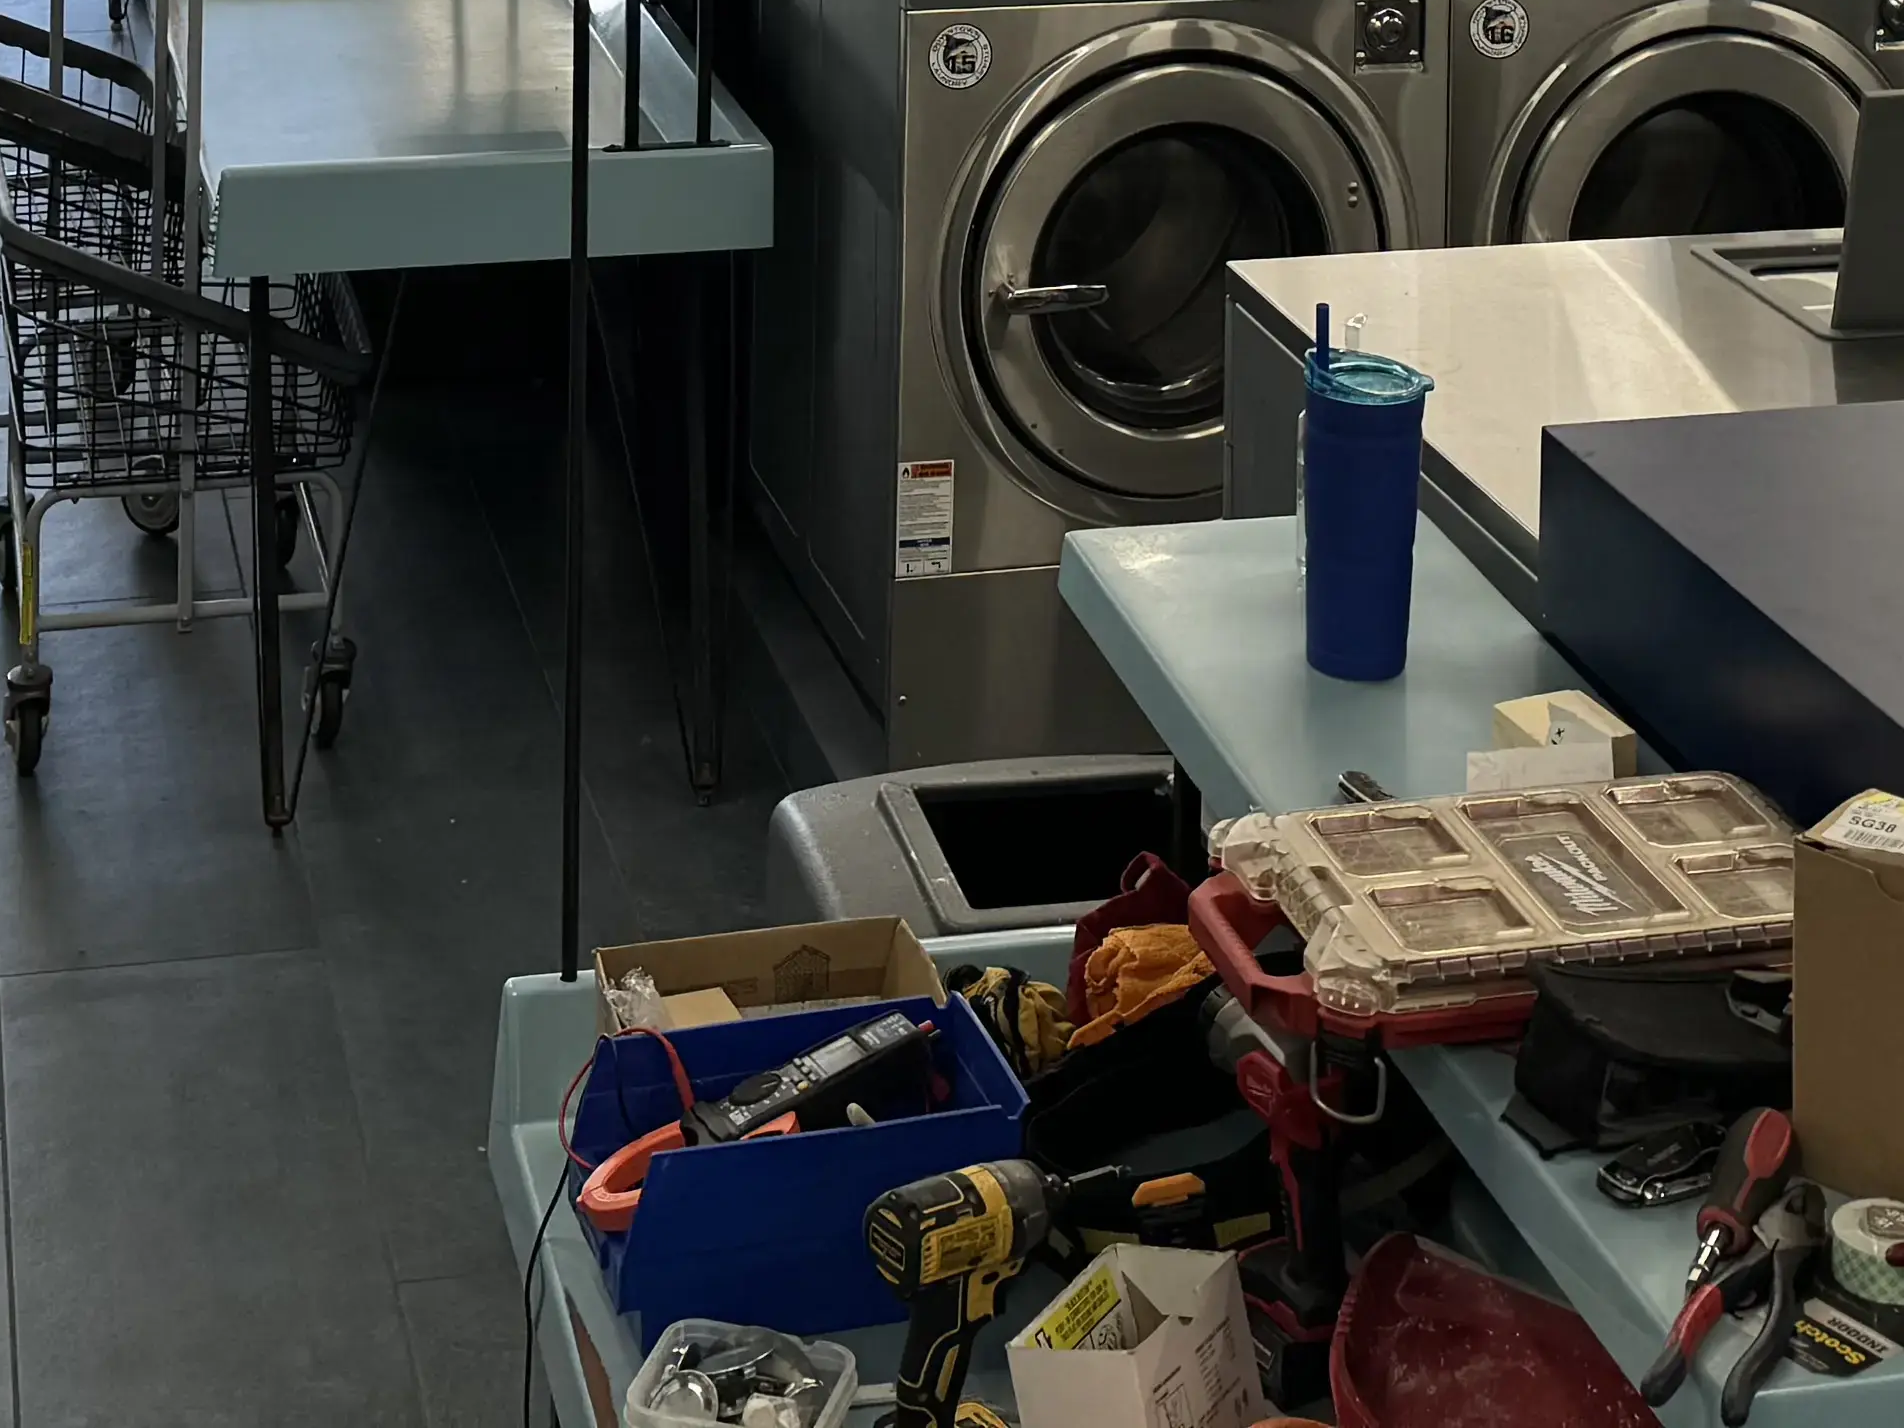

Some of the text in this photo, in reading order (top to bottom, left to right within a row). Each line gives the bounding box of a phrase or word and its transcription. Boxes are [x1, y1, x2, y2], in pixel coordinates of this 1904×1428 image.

[1487, 25, 1514, 45] 16
[949, 55, 976, 74] 15
[1794, 1319, 1866, 1365] Scotch
[1826, 1316, 1890, 1354] INDOOR
